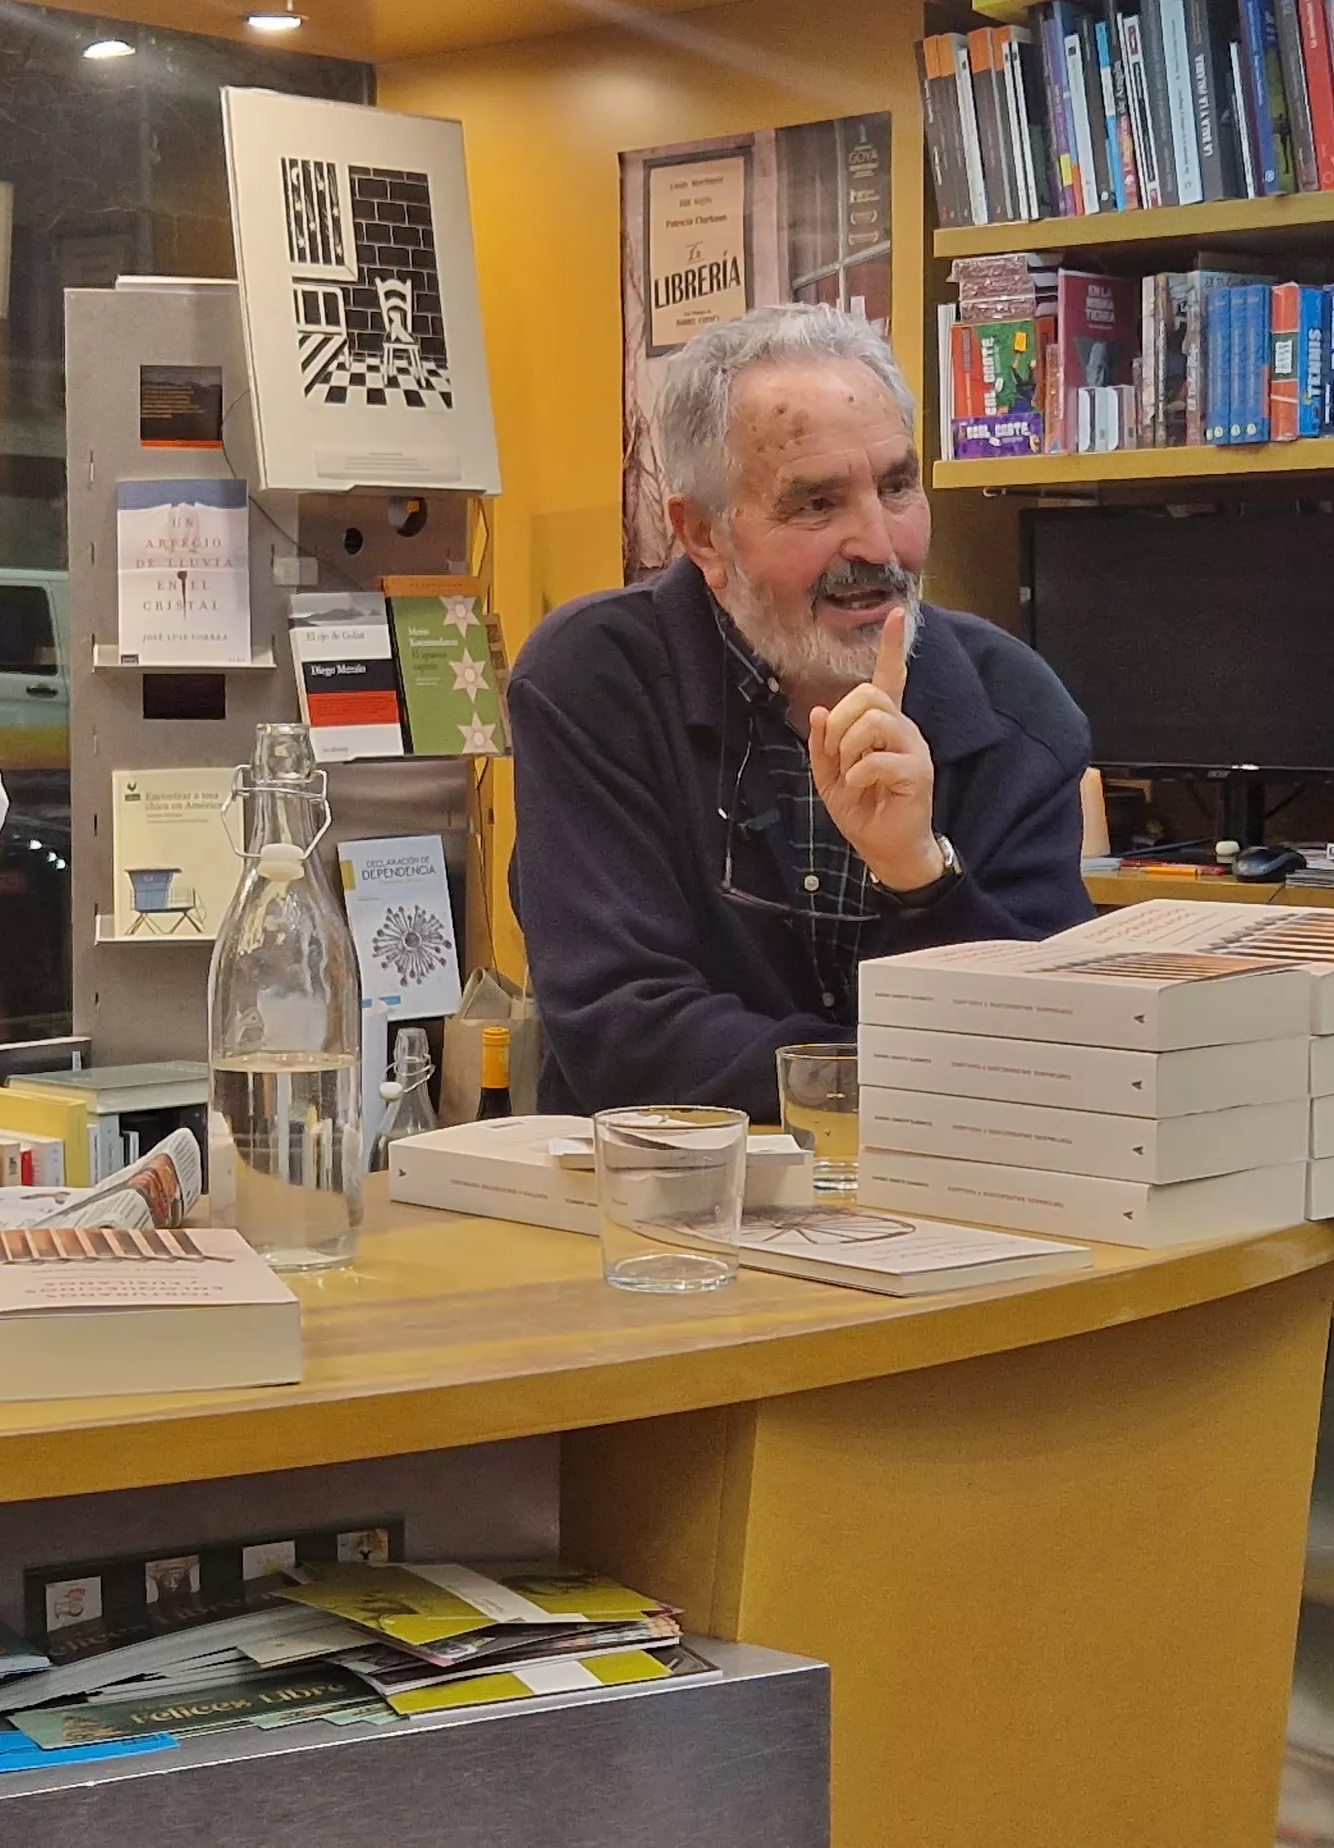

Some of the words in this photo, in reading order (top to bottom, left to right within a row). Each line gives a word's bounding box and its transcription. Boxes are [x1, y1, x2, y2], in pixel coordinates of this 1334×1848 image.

[1194, 54, 1209, 95] PALABRA
[1197, 96, 1211, 109] LA
[1204, 144, 1214, 157] LA
[653, 249, 741, 310] LIBRERÍA
[1306, 328, 1323, 398] TENNIS
[145, 537, 222, 549] ARPEGIO
[136, 558, 157, 569] DE
[168, 558, 234, 568] LLUVIA
[157, 580, 178, 591] EN
[143, 600, 223, 612] CRISTAL
[361, 864, 436, 881] DEPENDENCIA
